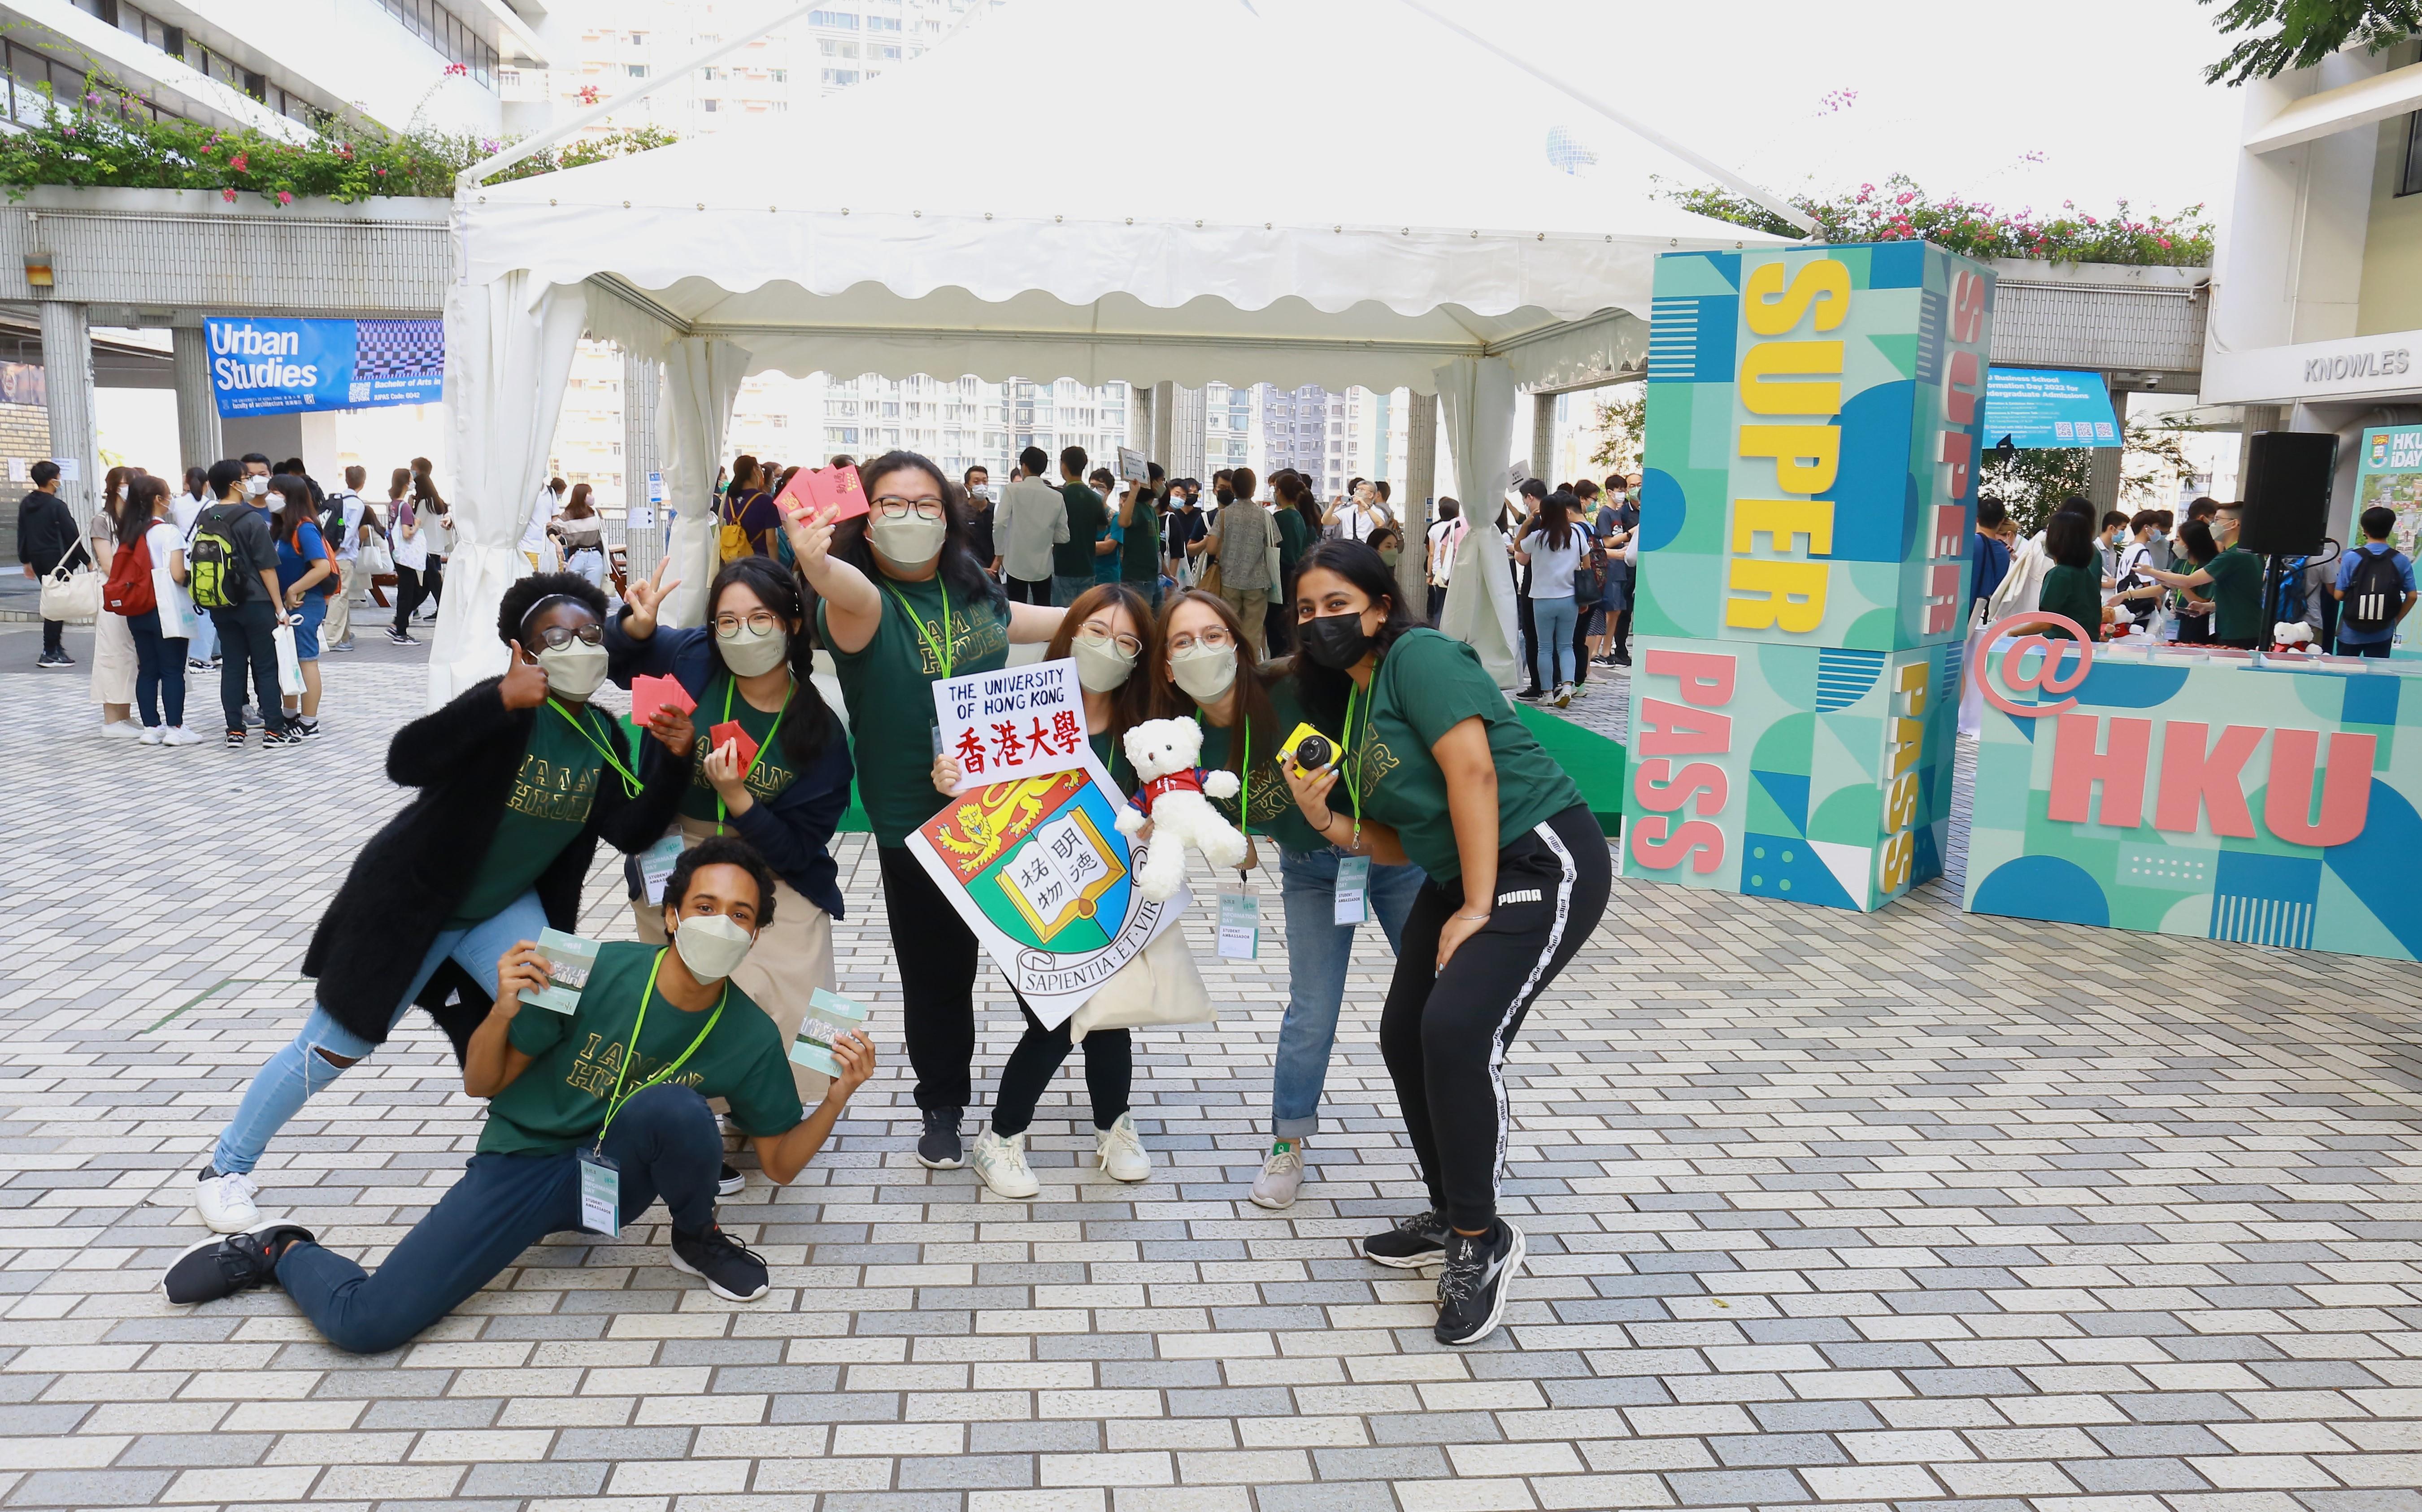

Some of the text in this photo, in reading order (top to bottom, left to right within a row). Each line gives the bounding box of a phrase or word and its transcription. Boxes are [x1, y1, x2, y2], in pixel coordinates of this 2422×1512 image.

[210, 323, 299, 355] Urban
[215, 356, 318, 391] Studies
[2304, 348, 2409, 382] KNOWLES
[374, 380, 406, 389] Bachelor
[434, 378, 441, 386] in
[1726, 258, 1851, 633] SUPER
[1923, 269, 1985, 635] SUPER
[1974, 611, 2094, 717] @
[948, 668, 1064, 702] THE UNIVERSITY
[957, 687, 1065, 720] OF HONG KONG
[955, 710, 1082, 774] 香港大學
[1631, 649, 1737, 873] PASS
[1879, 661, 1929, 895] PASS
[2048, 713, 2378, 847] HKU
[1548, 835, 1564, 853] PUMA
[1021, 857, 1064, 910] 格物
[1497, 889, 1543, 907] PUMA
[1025, 899, 1159, 992] SAPIENTIA ET VIR
[579, 1032, 602, 1060] I
[584, 1180, 617, 1196] INFORMATION
[584, 1186, 595, 1195] DAY
[585, 1197, 603, 1206] STUDENT
[585, 1203, 611, 1215] AMBASSADOR
